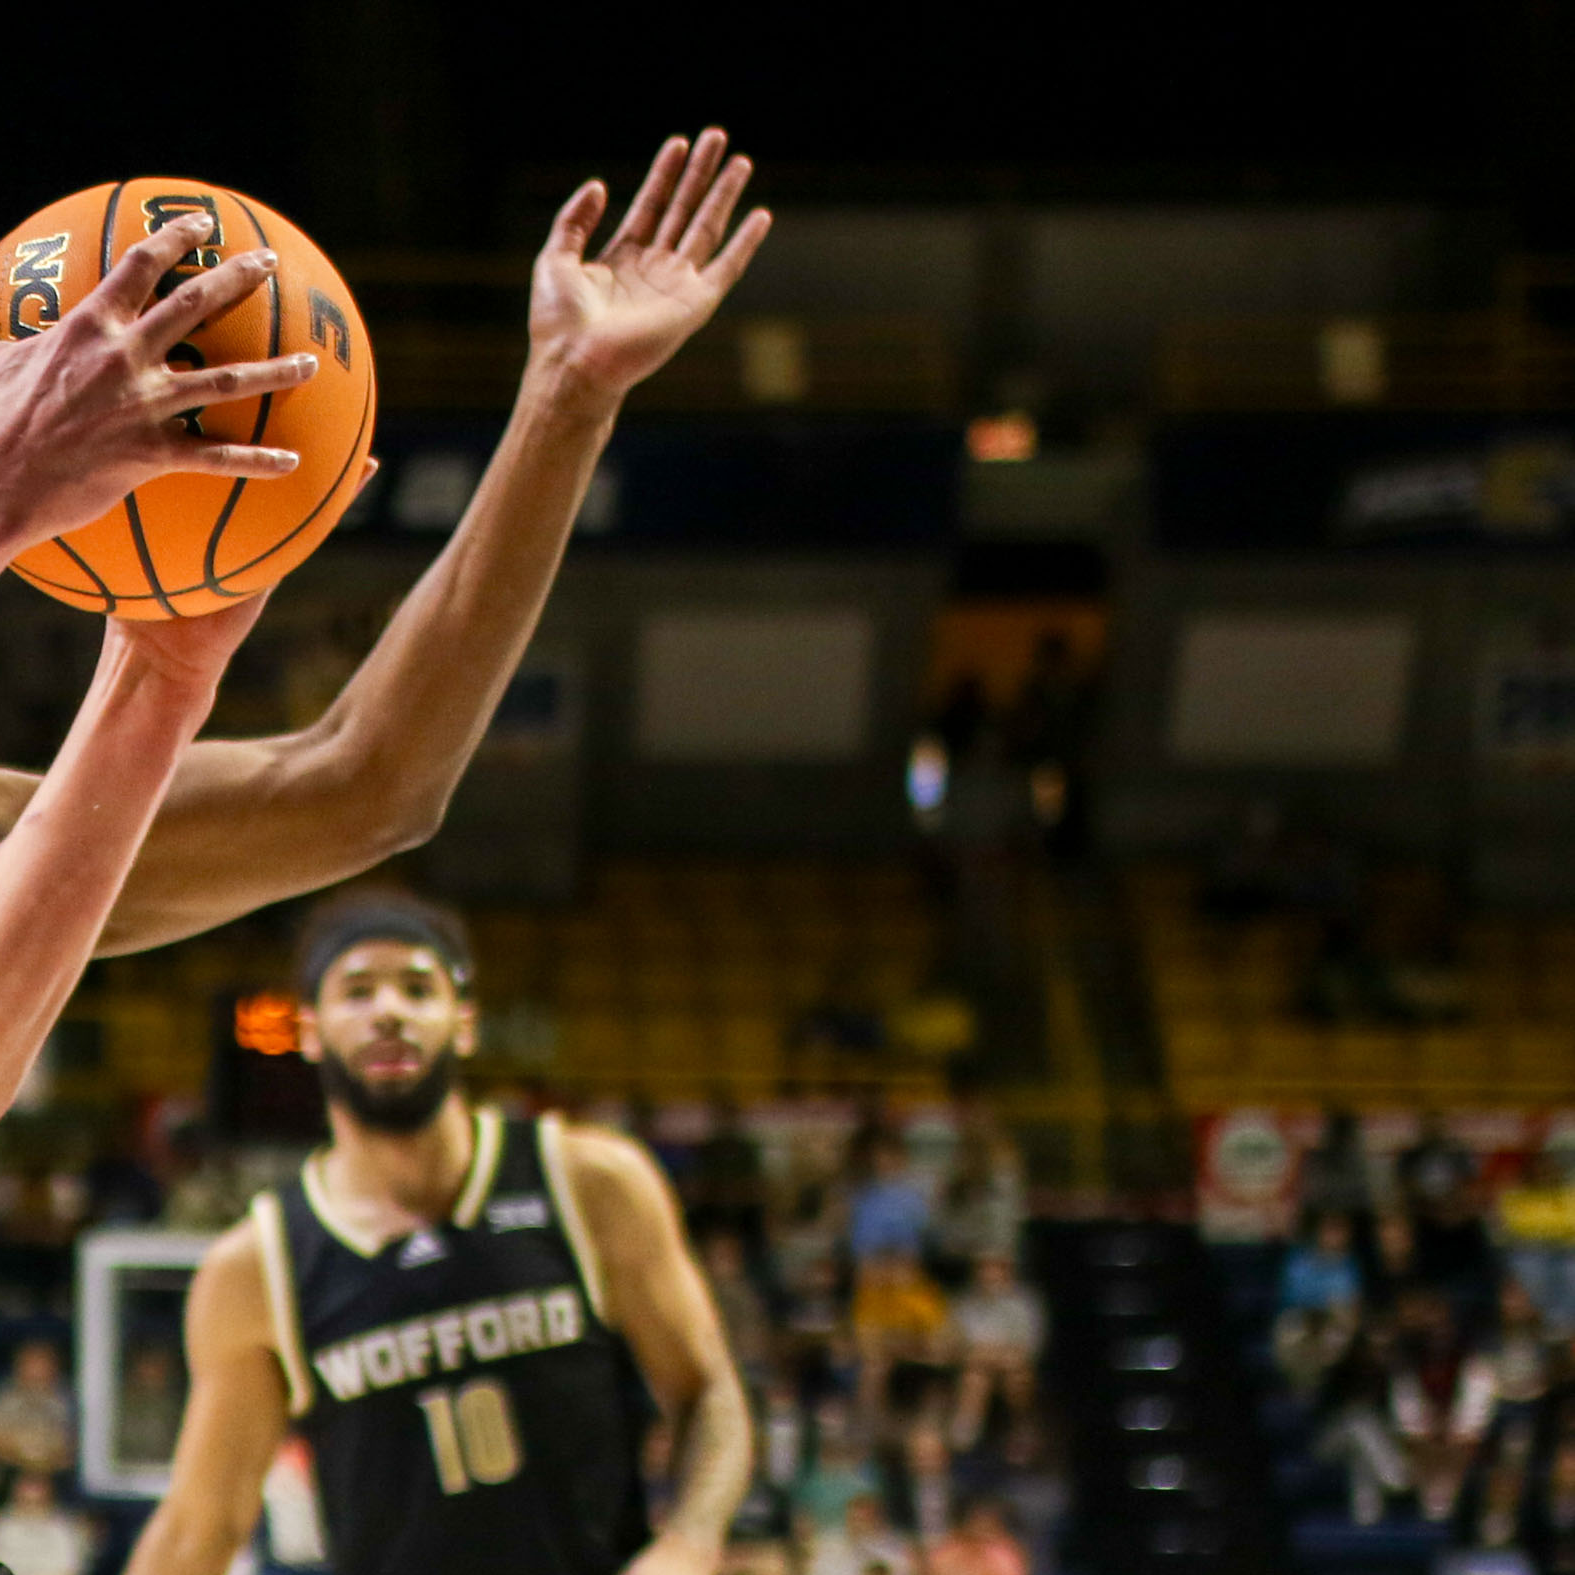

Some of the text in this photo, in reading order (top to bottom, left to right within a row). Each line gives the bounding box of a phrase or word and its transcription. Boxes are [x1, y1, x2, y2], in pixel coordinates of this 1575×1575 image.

[10, 232, 69, 340] NC
[314, 1286, 585, 1401] WOFFORD
[418, 1374, 523, 1495] 10
